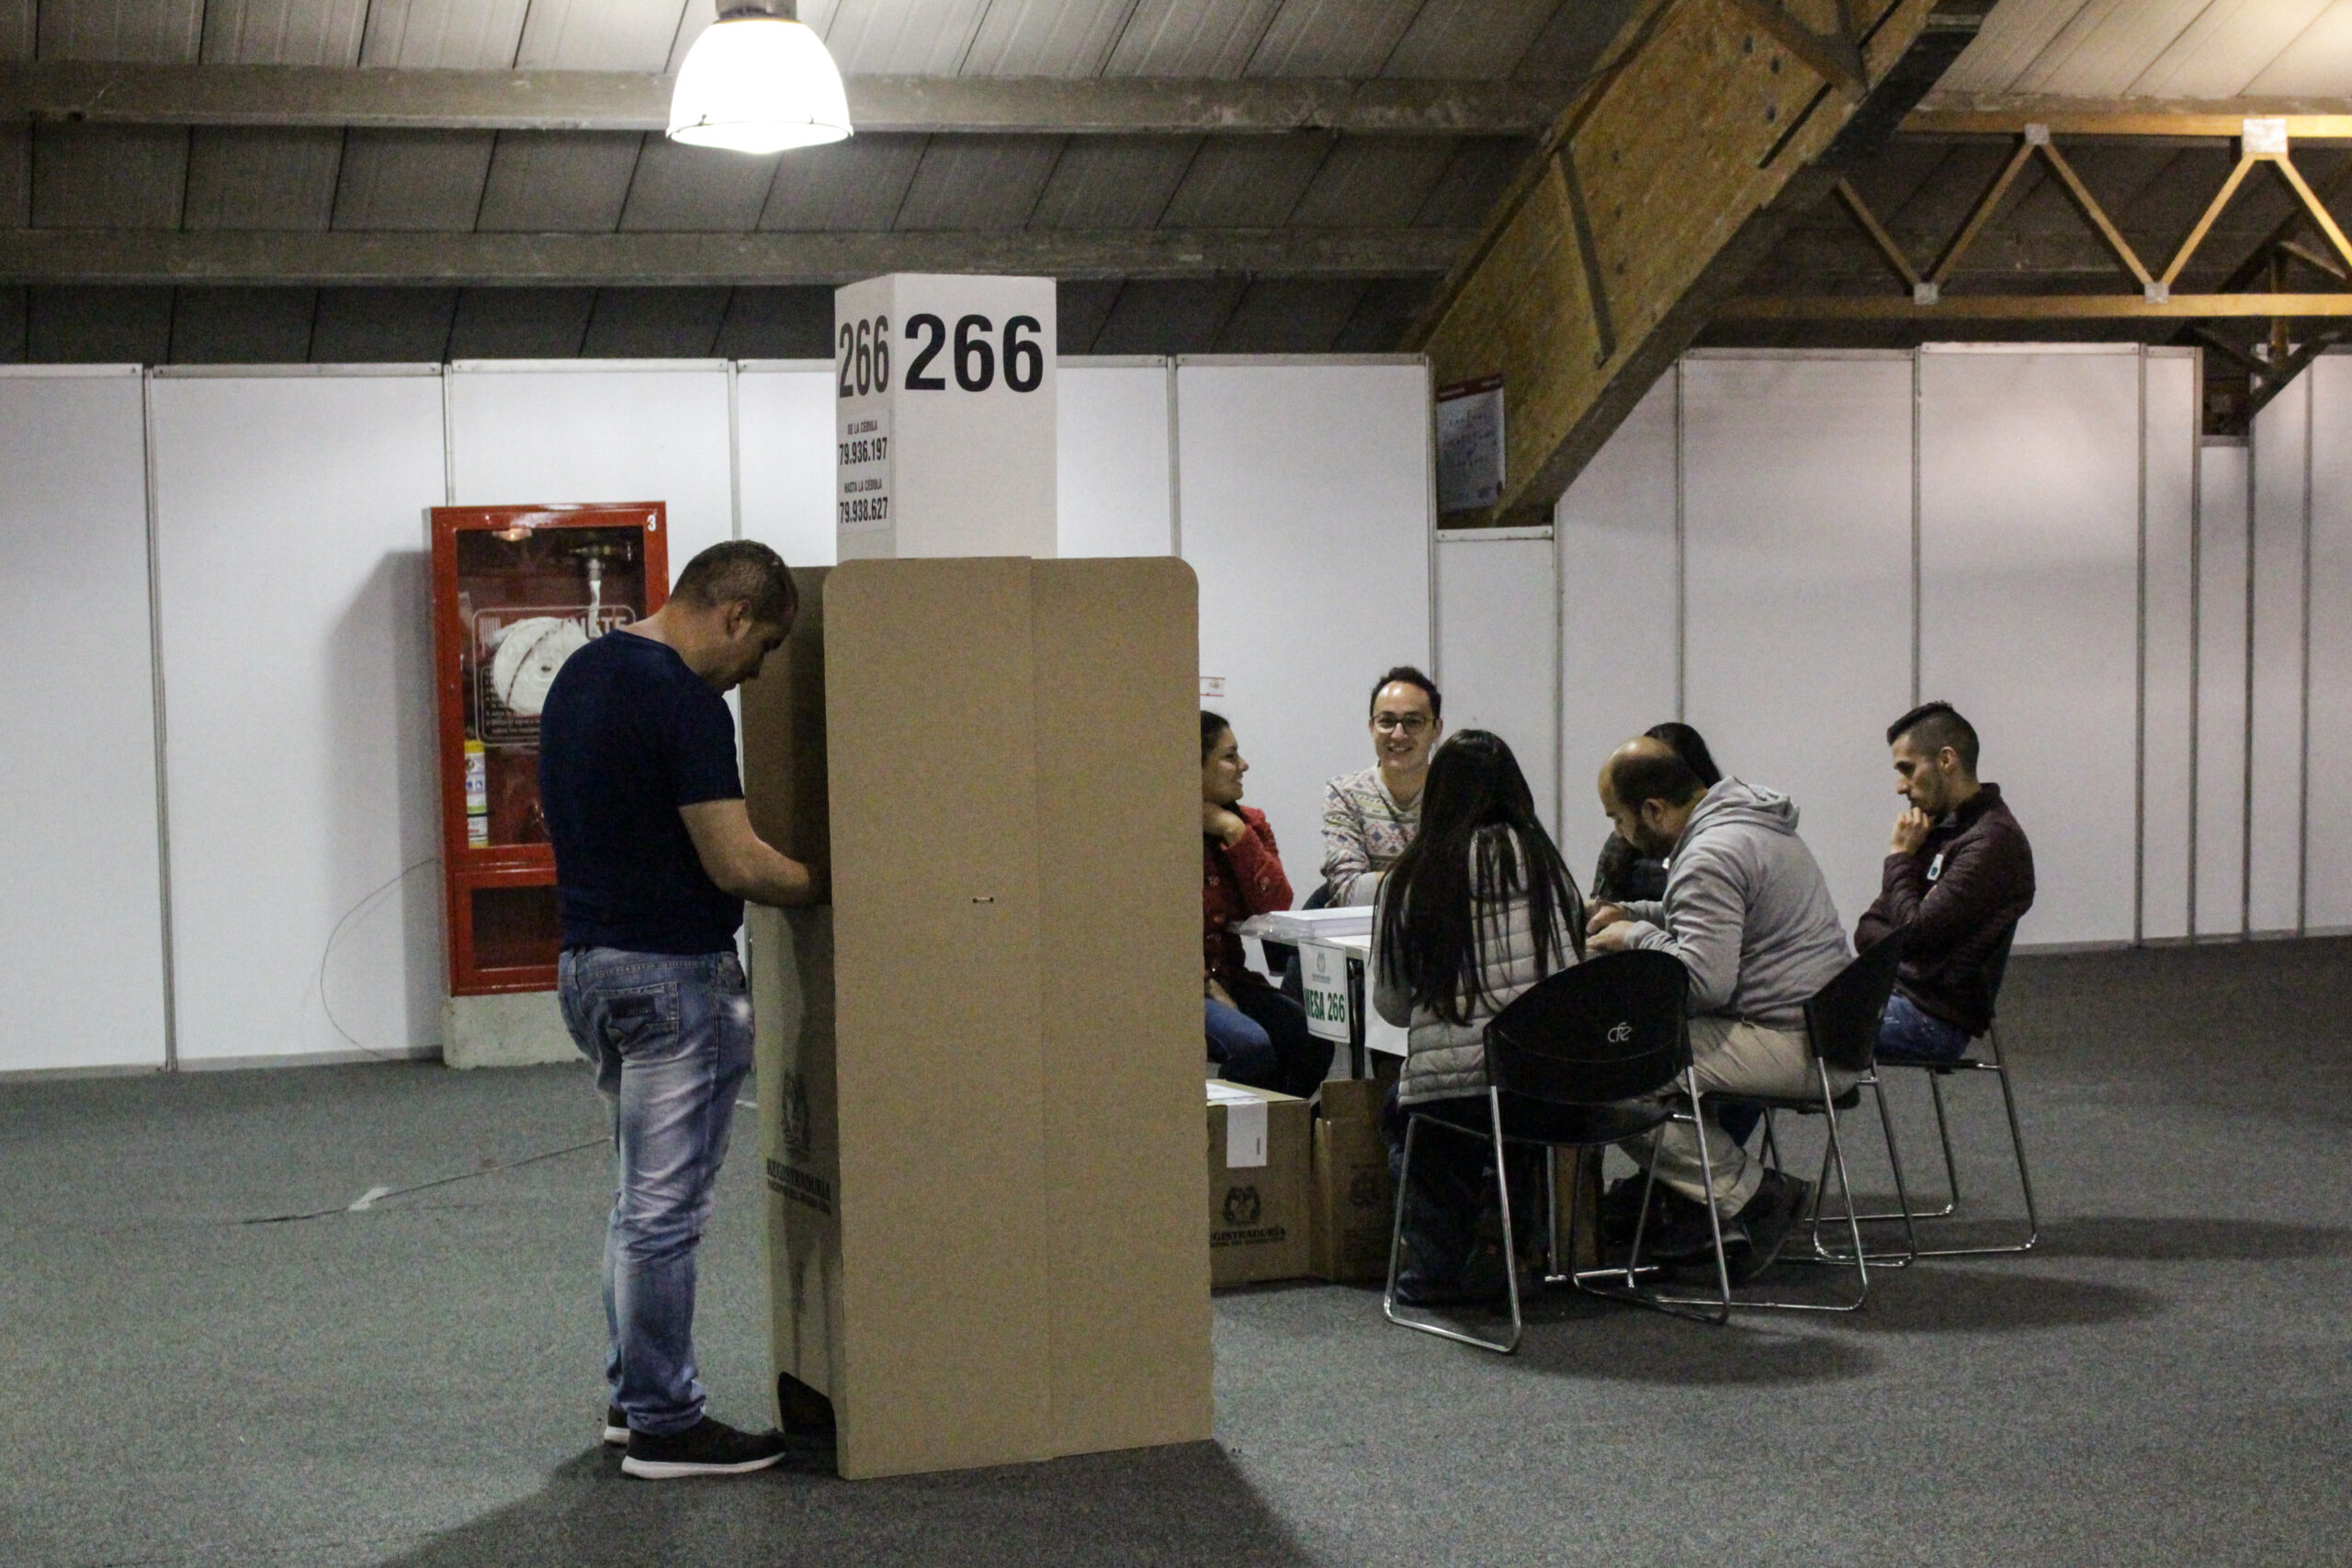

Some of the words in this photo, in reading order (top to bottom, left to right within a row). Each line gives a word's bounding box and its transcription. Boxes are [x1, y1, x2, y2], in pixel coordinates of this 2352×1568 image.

[839, 314, 889, 399] 266
[904, 313, 1044, 393] 266
[854, 423, 859, 434] LA
[839, 436, 888, 466] 79.936.197
[844, 481, 857, 493] HASTA
[858, 480, 864, 493] LA
[647, 513, 657, 532] 3
[840, 496, 888, 525] 79.938.627
[1305, 988, 1325, 1021] MESA
[1328, 992, 1345, 1022] 266
